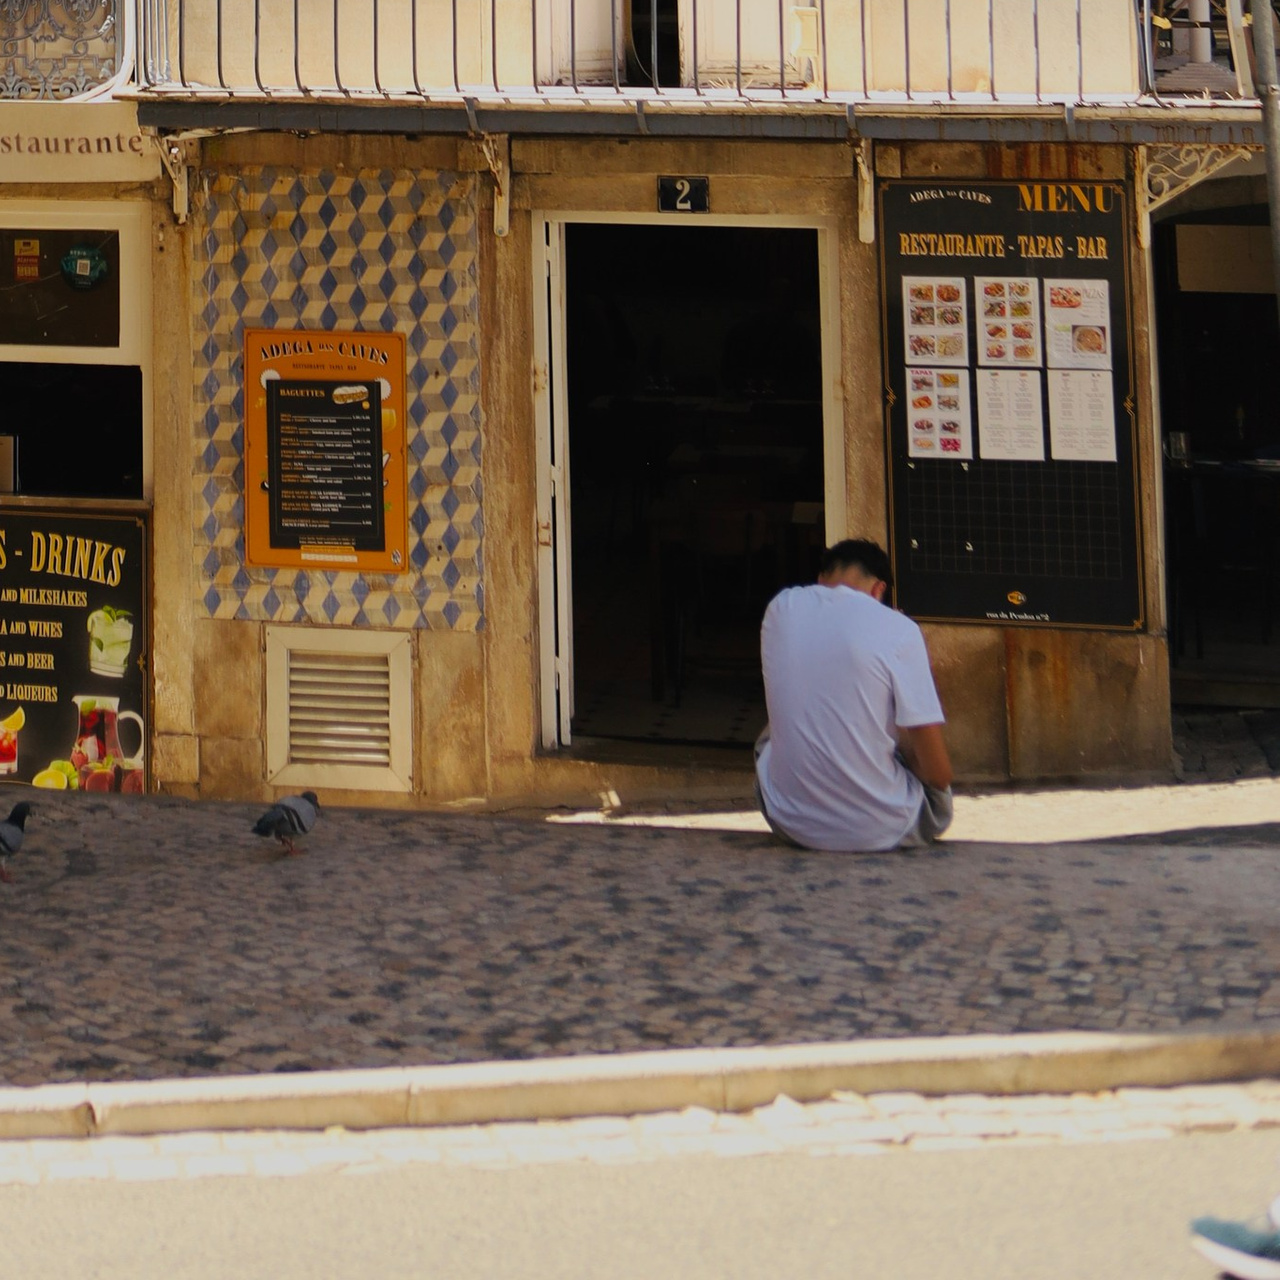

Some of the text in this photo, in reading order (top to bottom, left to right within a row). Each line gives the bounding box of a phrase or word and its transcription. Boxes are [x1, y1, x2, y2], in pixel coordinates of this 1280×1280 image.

[675, 179, 692, 210] 2
[909, 188, 945, 203] ADEGA
[959, 189, 993, 205] CAVES
[1017, 184, 1115, 213] MENU
[898, 232, 1006, 258] RESTAURANTE
[1017, 235, 1064, 259] TAPAS
[1076, 235, 1108, 260] BAR
[260, 340, 315, 362] ADEGA
[338, 342, 389, 366] CAVES
[279, 388, 326, 397] BAGUETTES
[29, 531, 127, 587] DRINKS
[0, 588, 88, 607] AND MILKSHAKES
[9, 621, 27, 635] AND
[28, 620, 63, 638] WINES
[8, 653, 25, 667] AND
[26, 652, 55, 670] BEER
[6, 683, 58, 703] LIQUEURS
